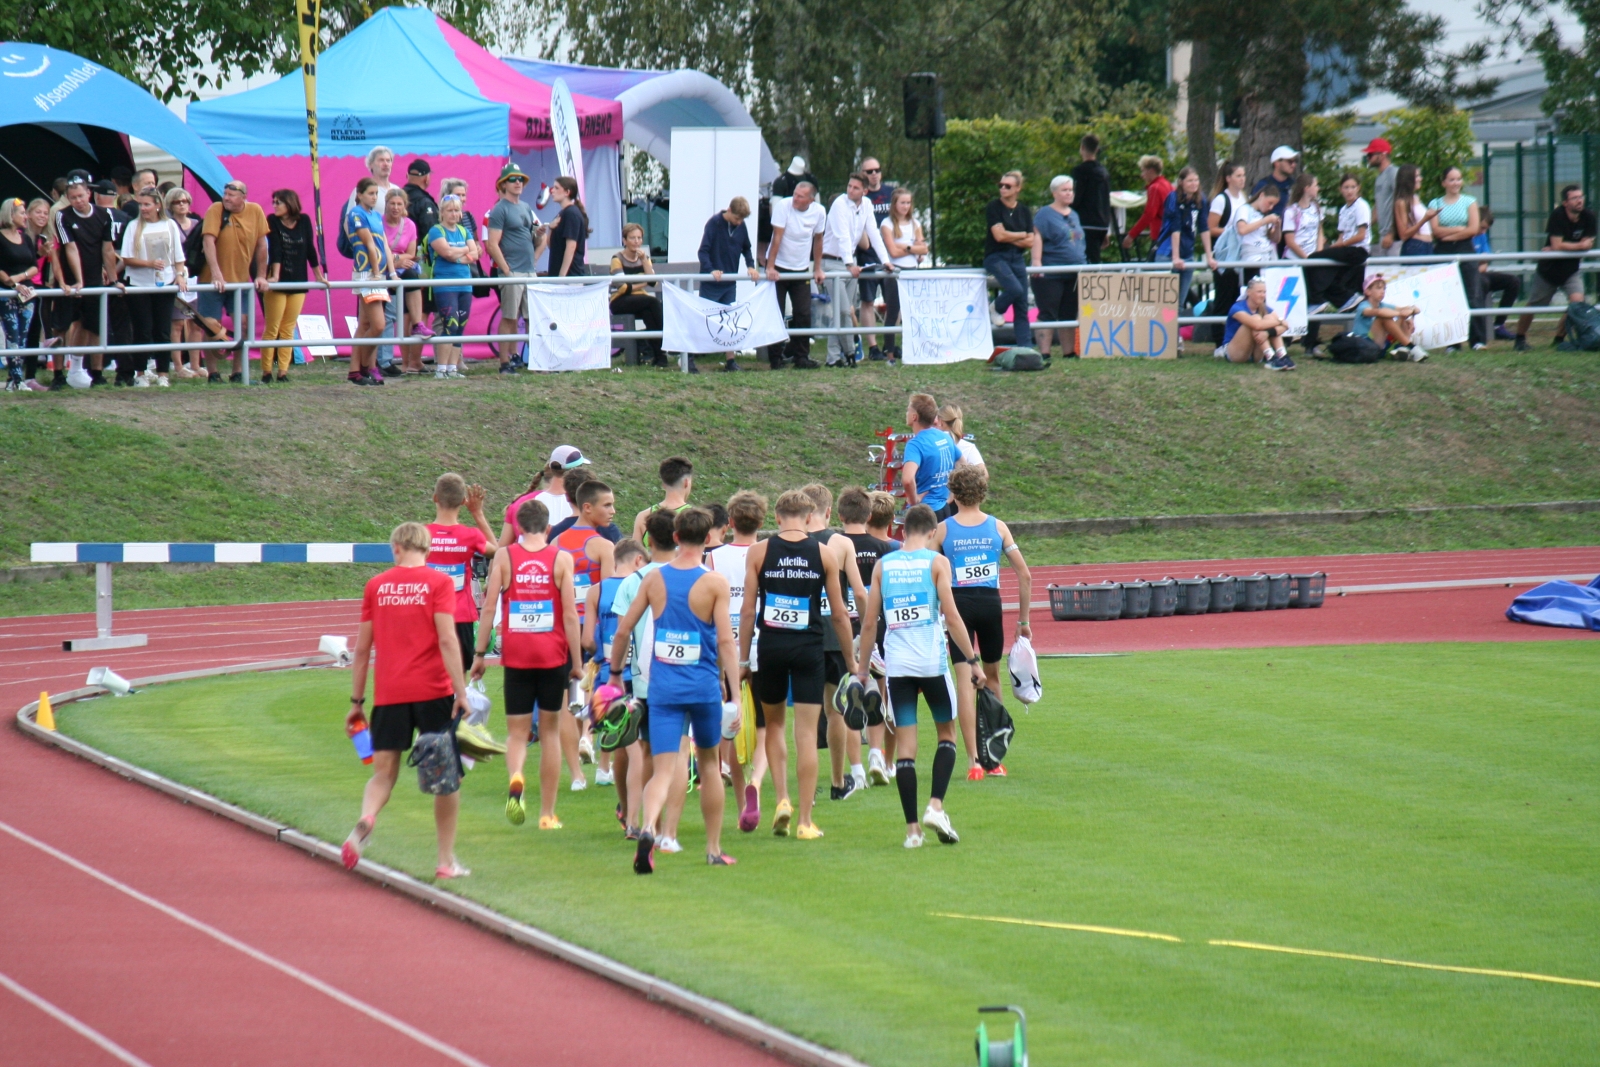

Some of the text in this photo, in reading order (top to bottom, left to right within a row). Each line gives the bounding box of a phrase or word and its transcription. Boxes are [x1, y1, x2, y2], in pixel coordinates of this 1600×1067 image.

[33, 62, 101, 112] #JsemAtlet
[577, 112, 612, 138] LANSKO
[907, 278, 974, 298] TEAMWORK
[1081, 275, 1178, 304] BEST ATHLETES
[934, 299, 949, 315] THE
[1098, 293, 1160, 326] are from
[910, 315, 949, 339] DREAM
[713, 334, 746, 347] BLANSKO
[1083, 319, 1169, 357] AKLD
[911, 340, 944, 359] WORK
[953, 538, 993, 547] TRIATLET
[777, 556, 808, 567] Atletika
[764, 568, 820, 579] stará Boleslav
[965, 565, 990, 579] 586
[376, 583, 429, 595] ATLETIKA
[378, 594, 426, 606] LITOMYŠL
[519, 601, 537, 609] ČESKÁ
[775, 597, 792, 605] ČESKÁ
[893, 596, 911, 604] ČESKÁ
[521, 614, 541, 623] 497
[772, 608, 799, 623] 263
[894, 607, 920, 622] 185
[665, 631, 682, 640] ČESKÁ
[667, 645, 685, 658] 78
